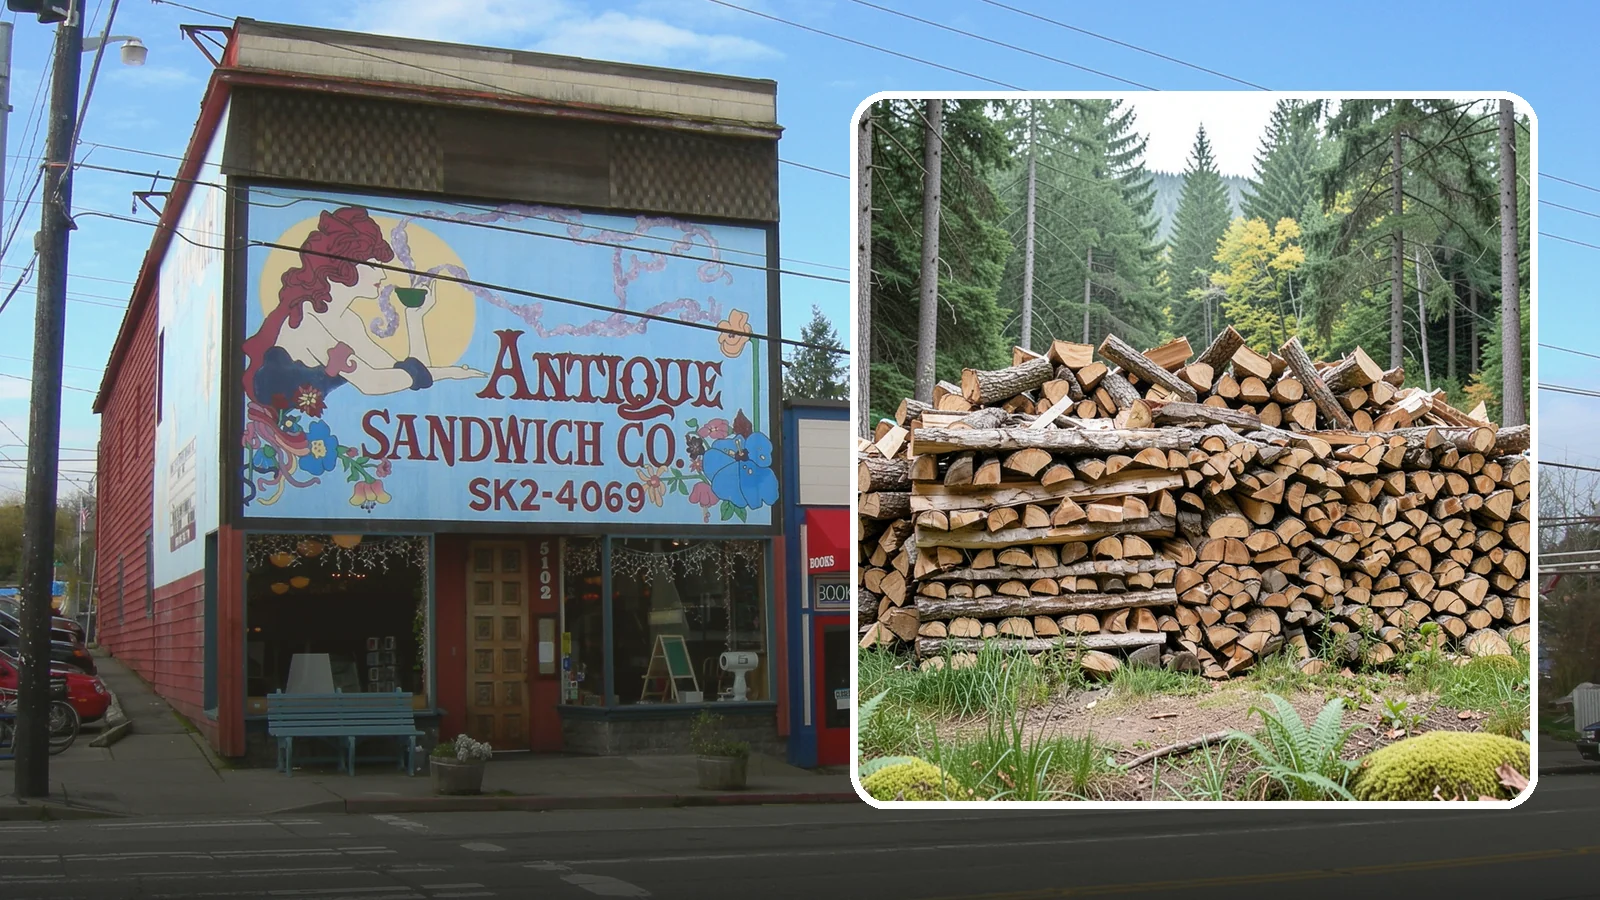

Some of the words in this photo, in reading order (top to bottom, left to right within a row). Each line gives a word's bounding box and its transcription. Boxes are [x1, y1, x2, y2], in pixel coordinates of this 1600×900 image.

[476, 329, 723, 421] ANTIQUE
[361, 409, 603, 467] SANDWICH
[617, 422, 685, 469] CO.
[468, 477, 645, 513] SK2-4069
[540, 541, 551, 600] 5102
[809, 555, 835, 569] BOOKS
